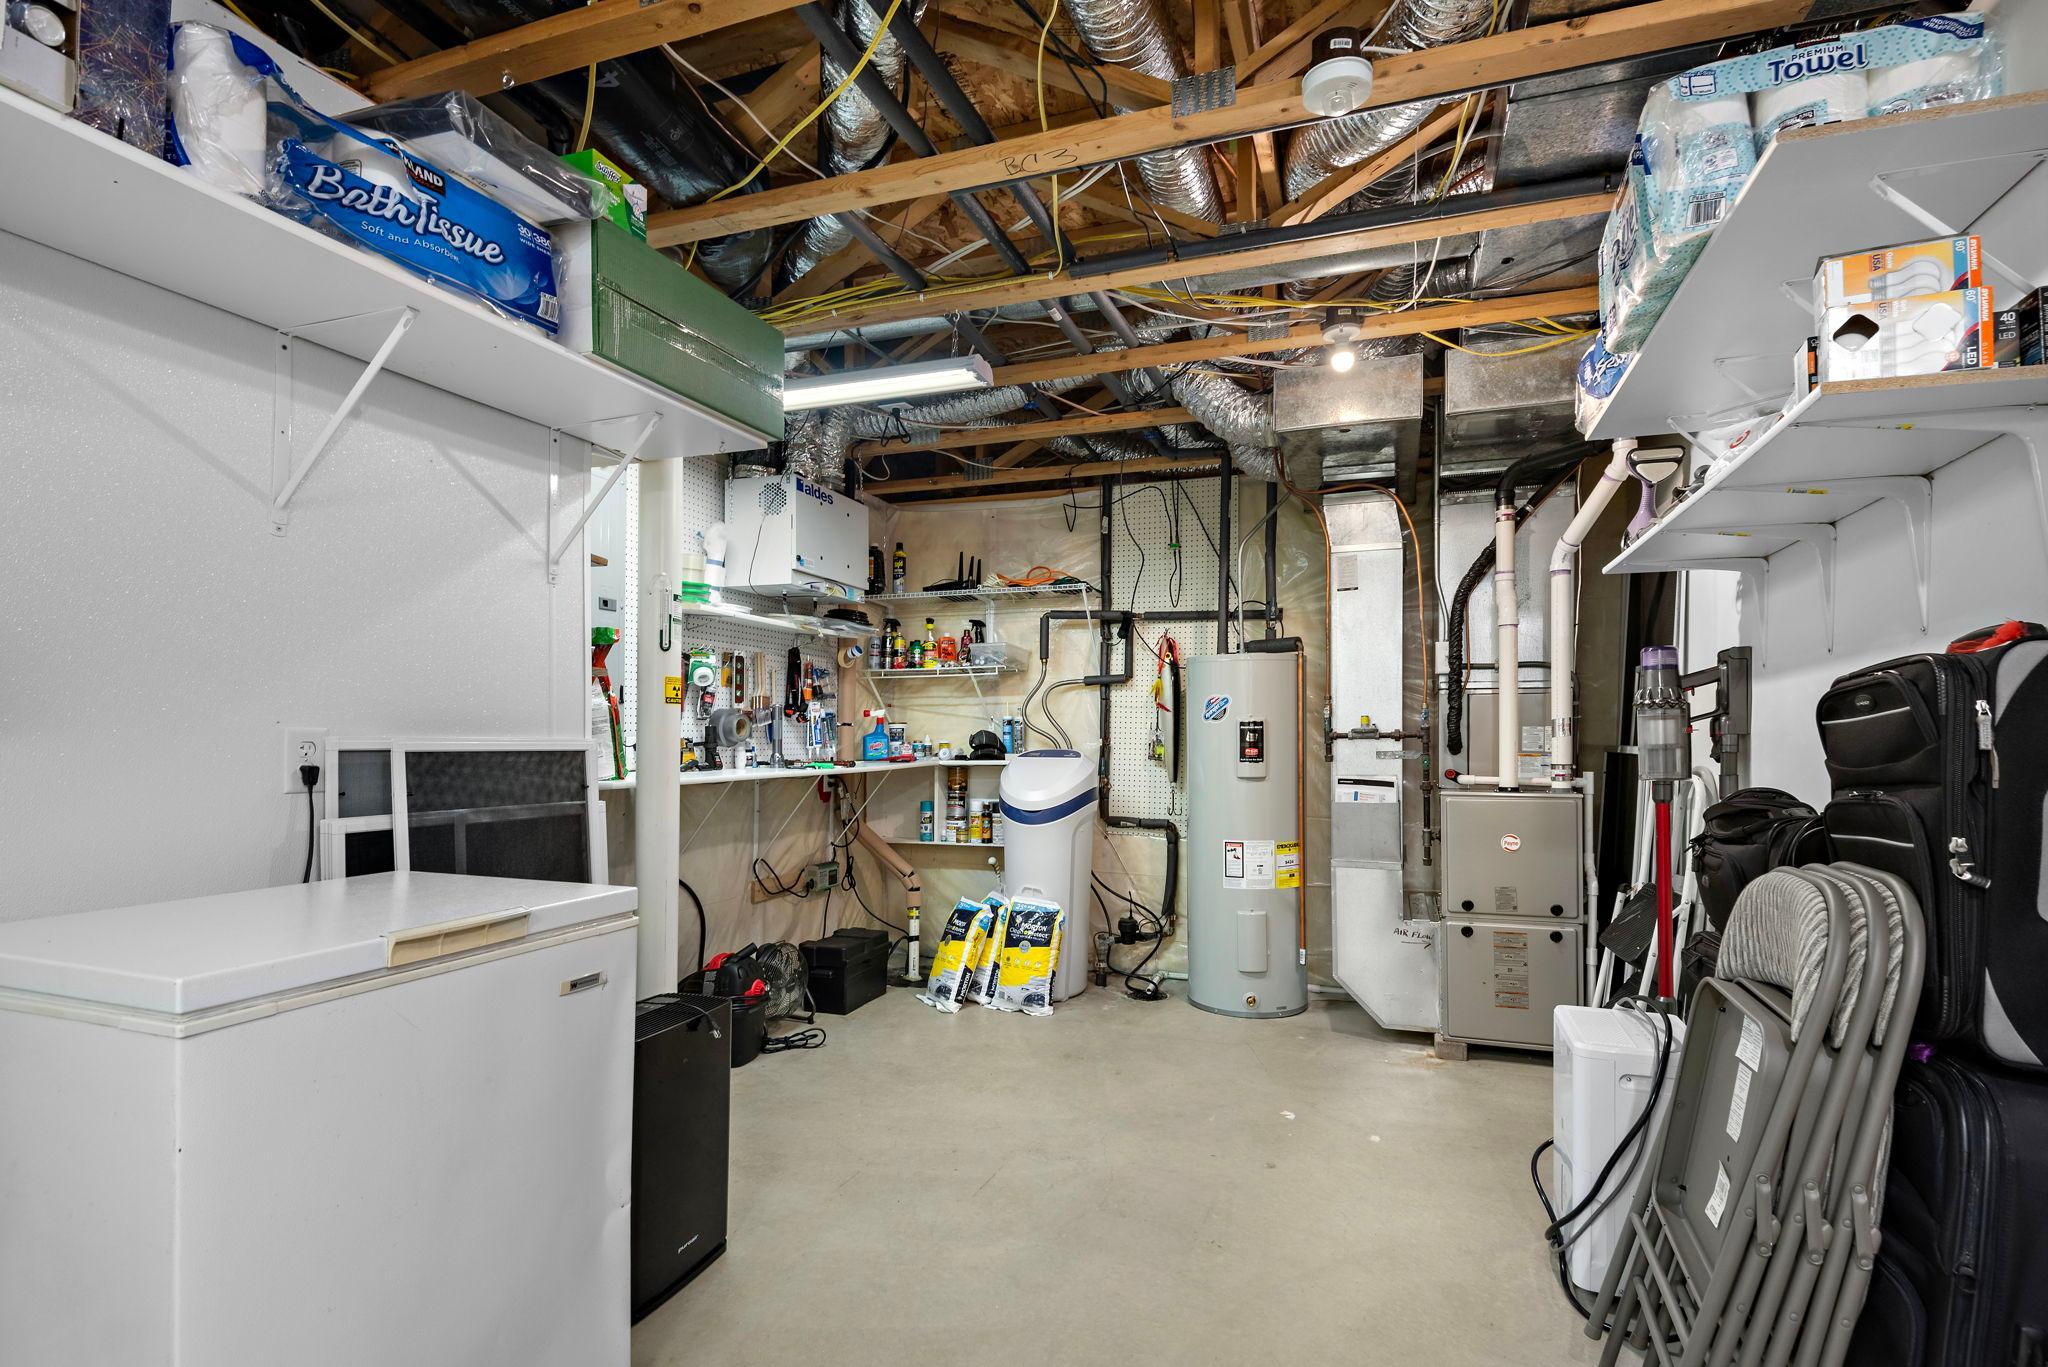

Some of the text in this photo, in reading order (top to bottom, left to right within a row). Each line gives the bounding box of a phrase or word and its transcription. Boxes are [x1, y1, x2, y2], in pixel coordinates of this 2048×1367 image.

[1922, 20, 1956, 32] WRAPPED
[1791, 45, 1844, 61] PREMIUM
[1768, 43, 1868, 85] Towel
[595, 160, 621, 184] Swiffer
[308, 164, 505, 265] Bath Tissue
[361, 220, 385, 237] Soft
[387, 231, 409, 244] and
[517, 223, 532, 237] 30
[1873, 254, 1881, 271] USA
[1879, 302, 1887, 321] USA
[2000, 312, 2016, 322] 40
[1998, 331, 2017, 340] LED
[1967, 346, 1977, 365] LED
[805, 484, 834, 505] aldes
[1394, 928, 1434, 940] AIR FLOW
[961, 972, 971, 997] MORTON
